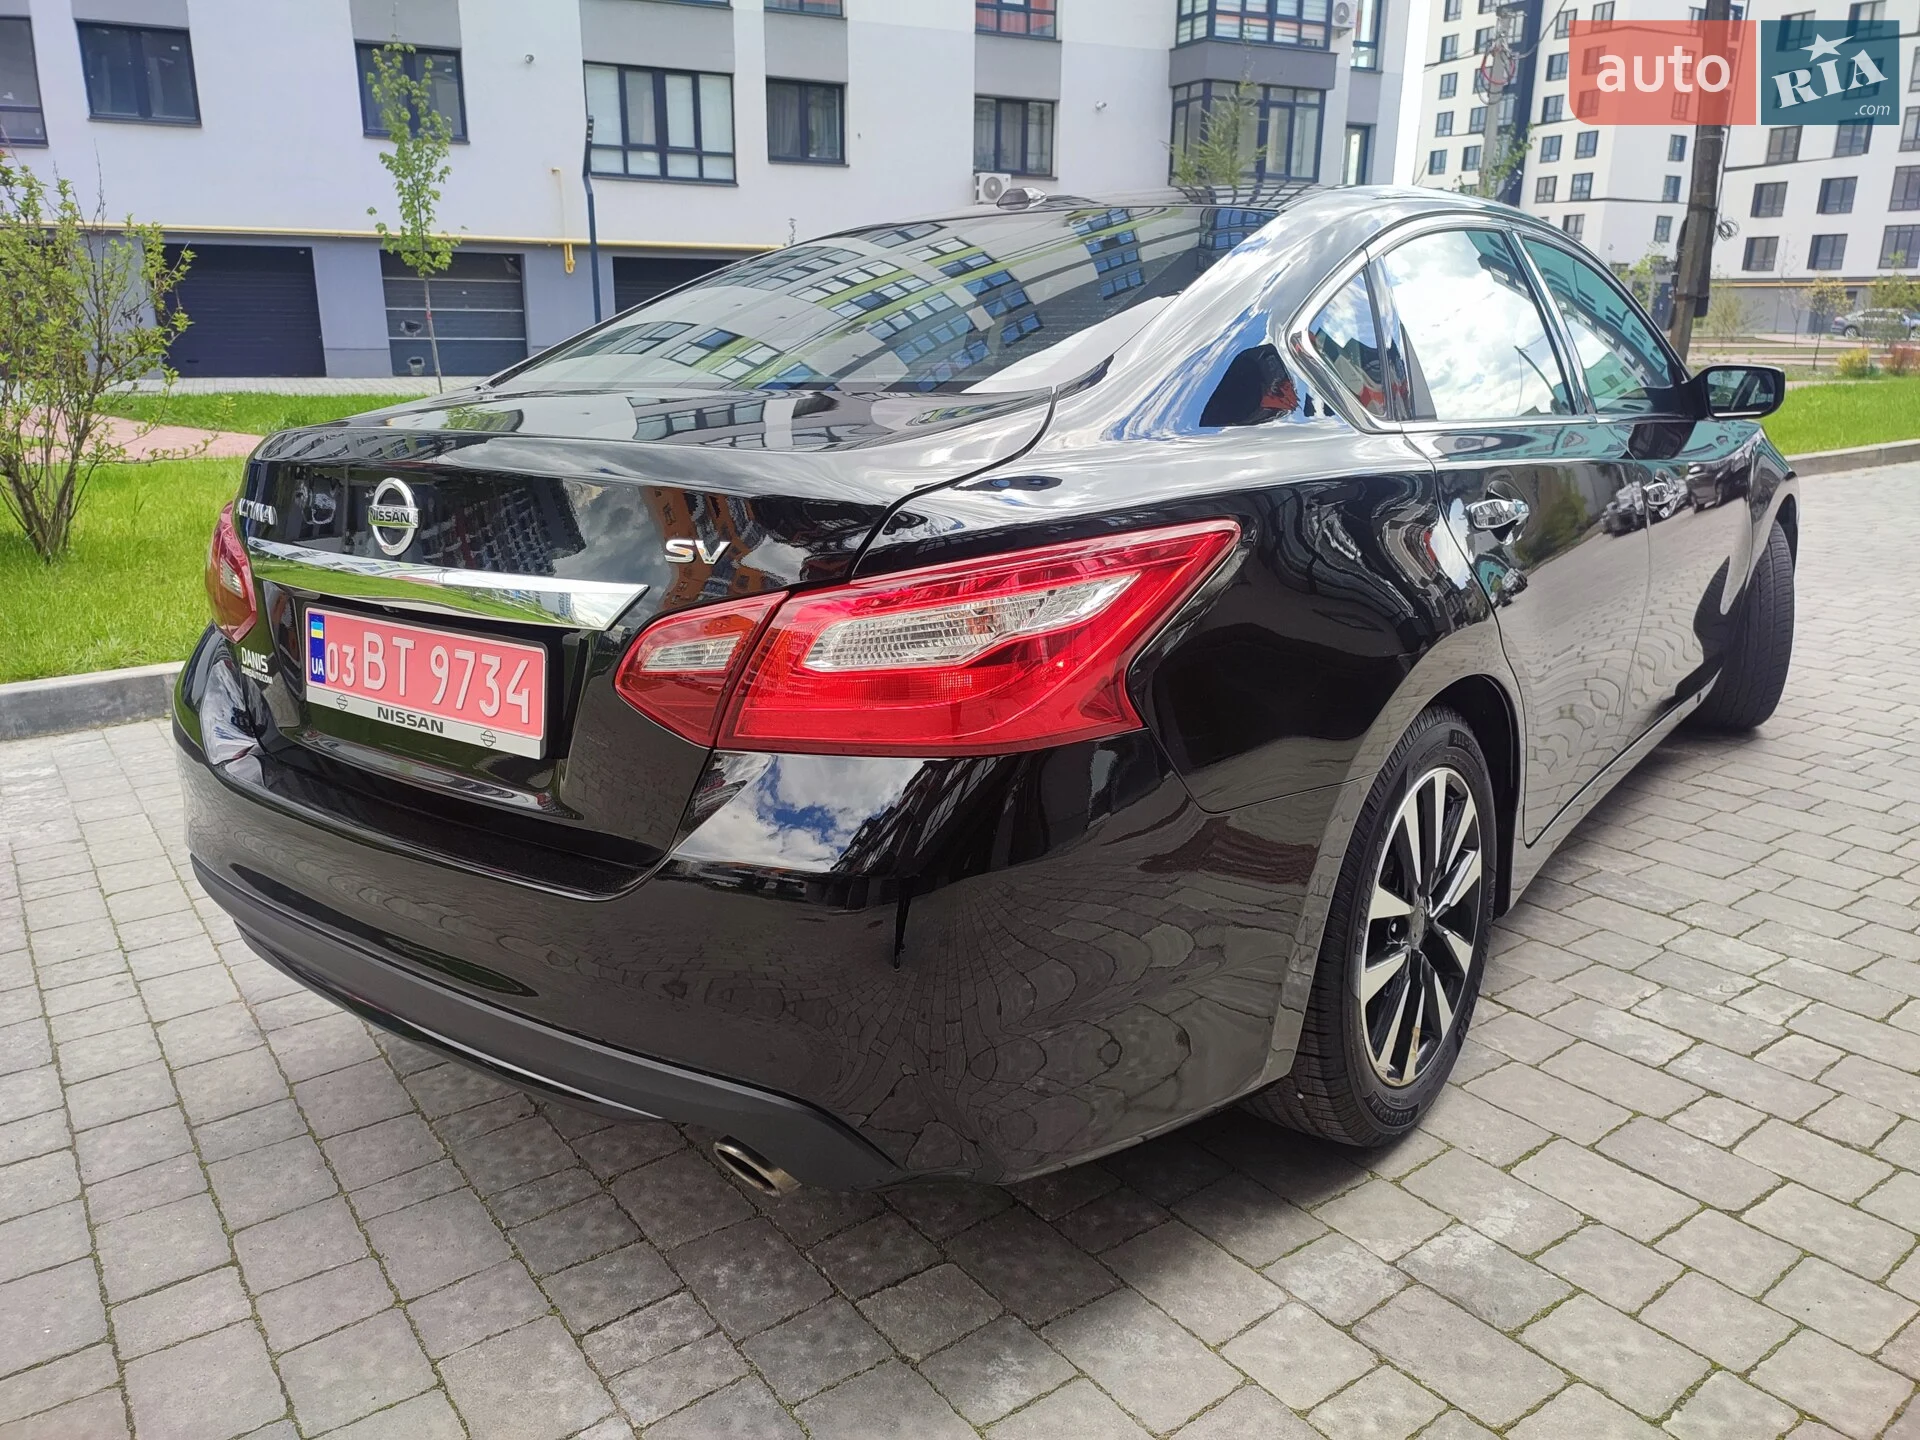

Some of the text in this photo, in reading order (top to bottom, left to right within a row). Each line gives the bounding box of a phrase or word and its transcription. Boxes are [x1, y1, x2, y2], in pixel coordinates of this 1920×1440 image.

[370, 509, 410, 523] NISSAN
[664, 539, 731, 565] SV
[241, 646, 269, 673] DANIS
[311, 657, 325, 676] UA
[430, 645, 530, 724] 9734
[377, 706, 444, 734] NISSAN
